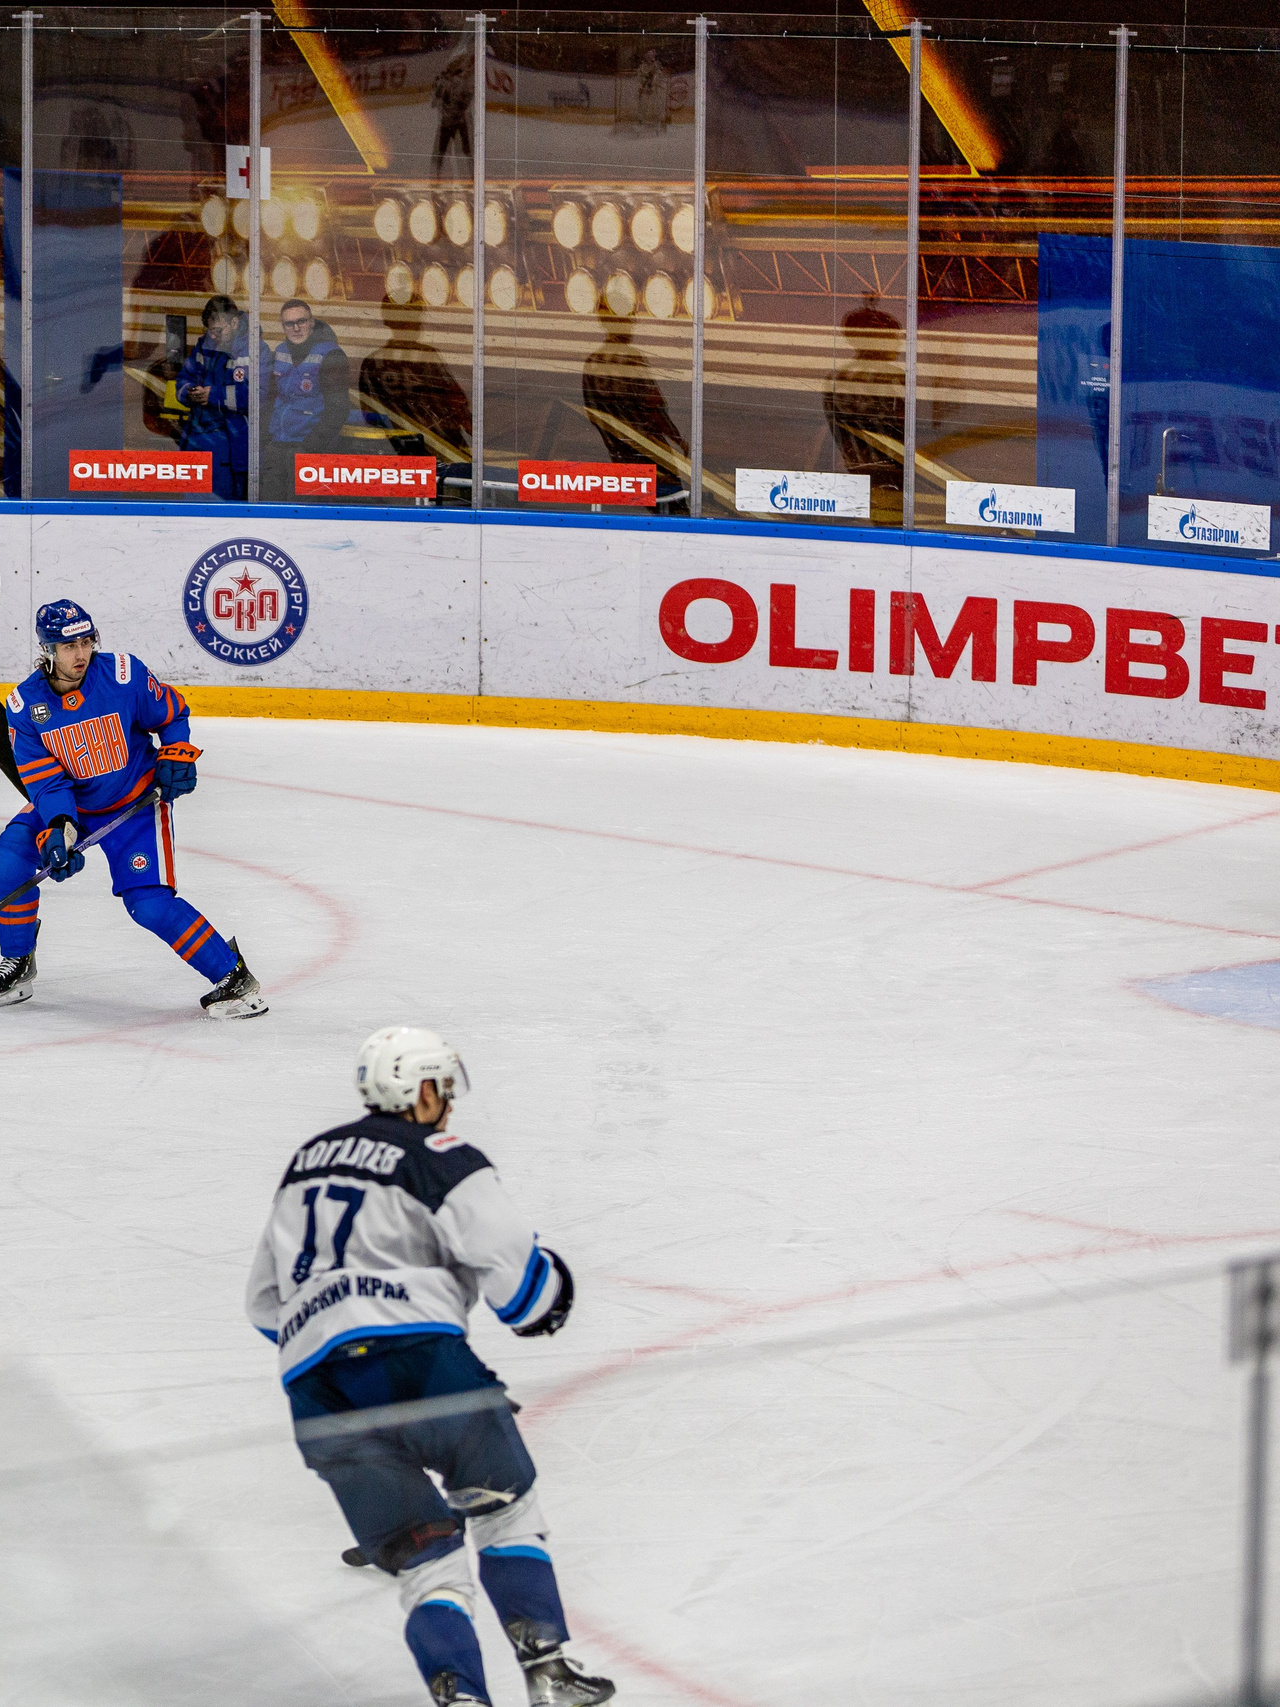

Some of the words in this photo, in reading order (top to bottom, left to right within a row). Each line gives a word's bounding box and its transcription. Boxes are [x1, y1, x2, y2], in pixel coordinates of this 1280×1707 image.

[73, 462, 208, 480] OLIMPBET
[298, 466, 432, 485] OLIMPBET
[522, 473, 652, 493] OLIMPBET
[789, 497, 836, 512] ГАЗПРОМ
[997, 510, 1042, 526] ГАЗПРОМ
[1196, 527, 1239, 543] ГАЗПРОМ
[188, 544, 303, 616] САНКТ-ПЕТЕРБУРГ
[213, 588, 279, 631] СКА
[64, 623, 89, 634] OLIMPBET
[208, 626, 283, 660] ХОККЕЙ
[658, 577, 1280, 711] OLIMPBE
[10, 690, 21, 709] PBET
[291, 1183, 367, 1285] 17
